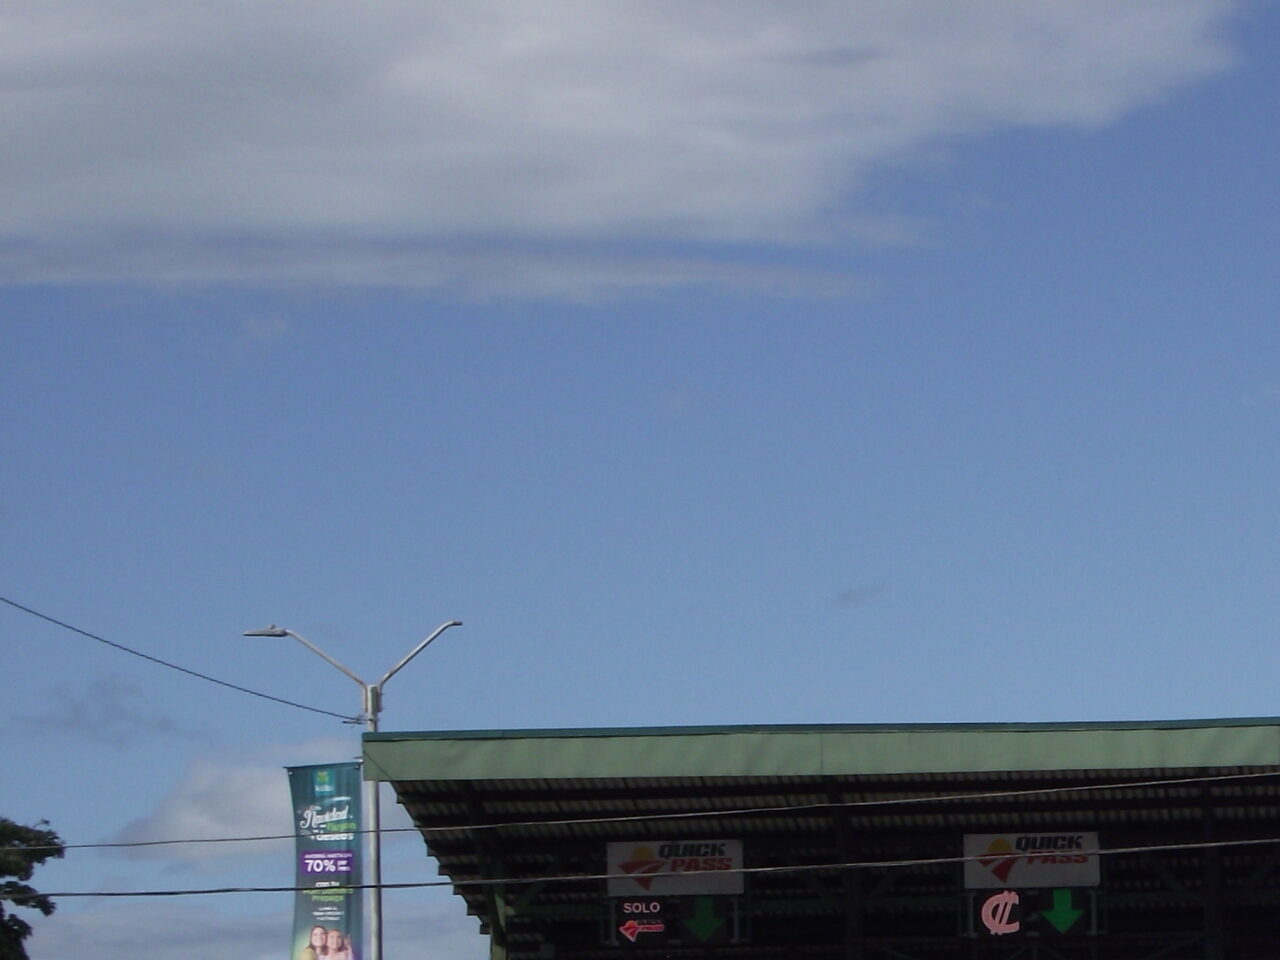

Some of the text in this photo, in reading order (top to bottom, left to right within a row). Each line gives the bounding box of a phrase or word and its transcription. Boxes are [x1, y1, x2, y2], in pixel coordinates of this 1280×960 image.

[1016, 835, 1083, 851] QUICK
[658, 842, 726, 859] QUICK
[670, 857, 733, 872] PASS
[1025, 851, 1089, 865] PASS
[304, 859, 336, 873] 70%
[623, 901, 661, 914] SOLO
